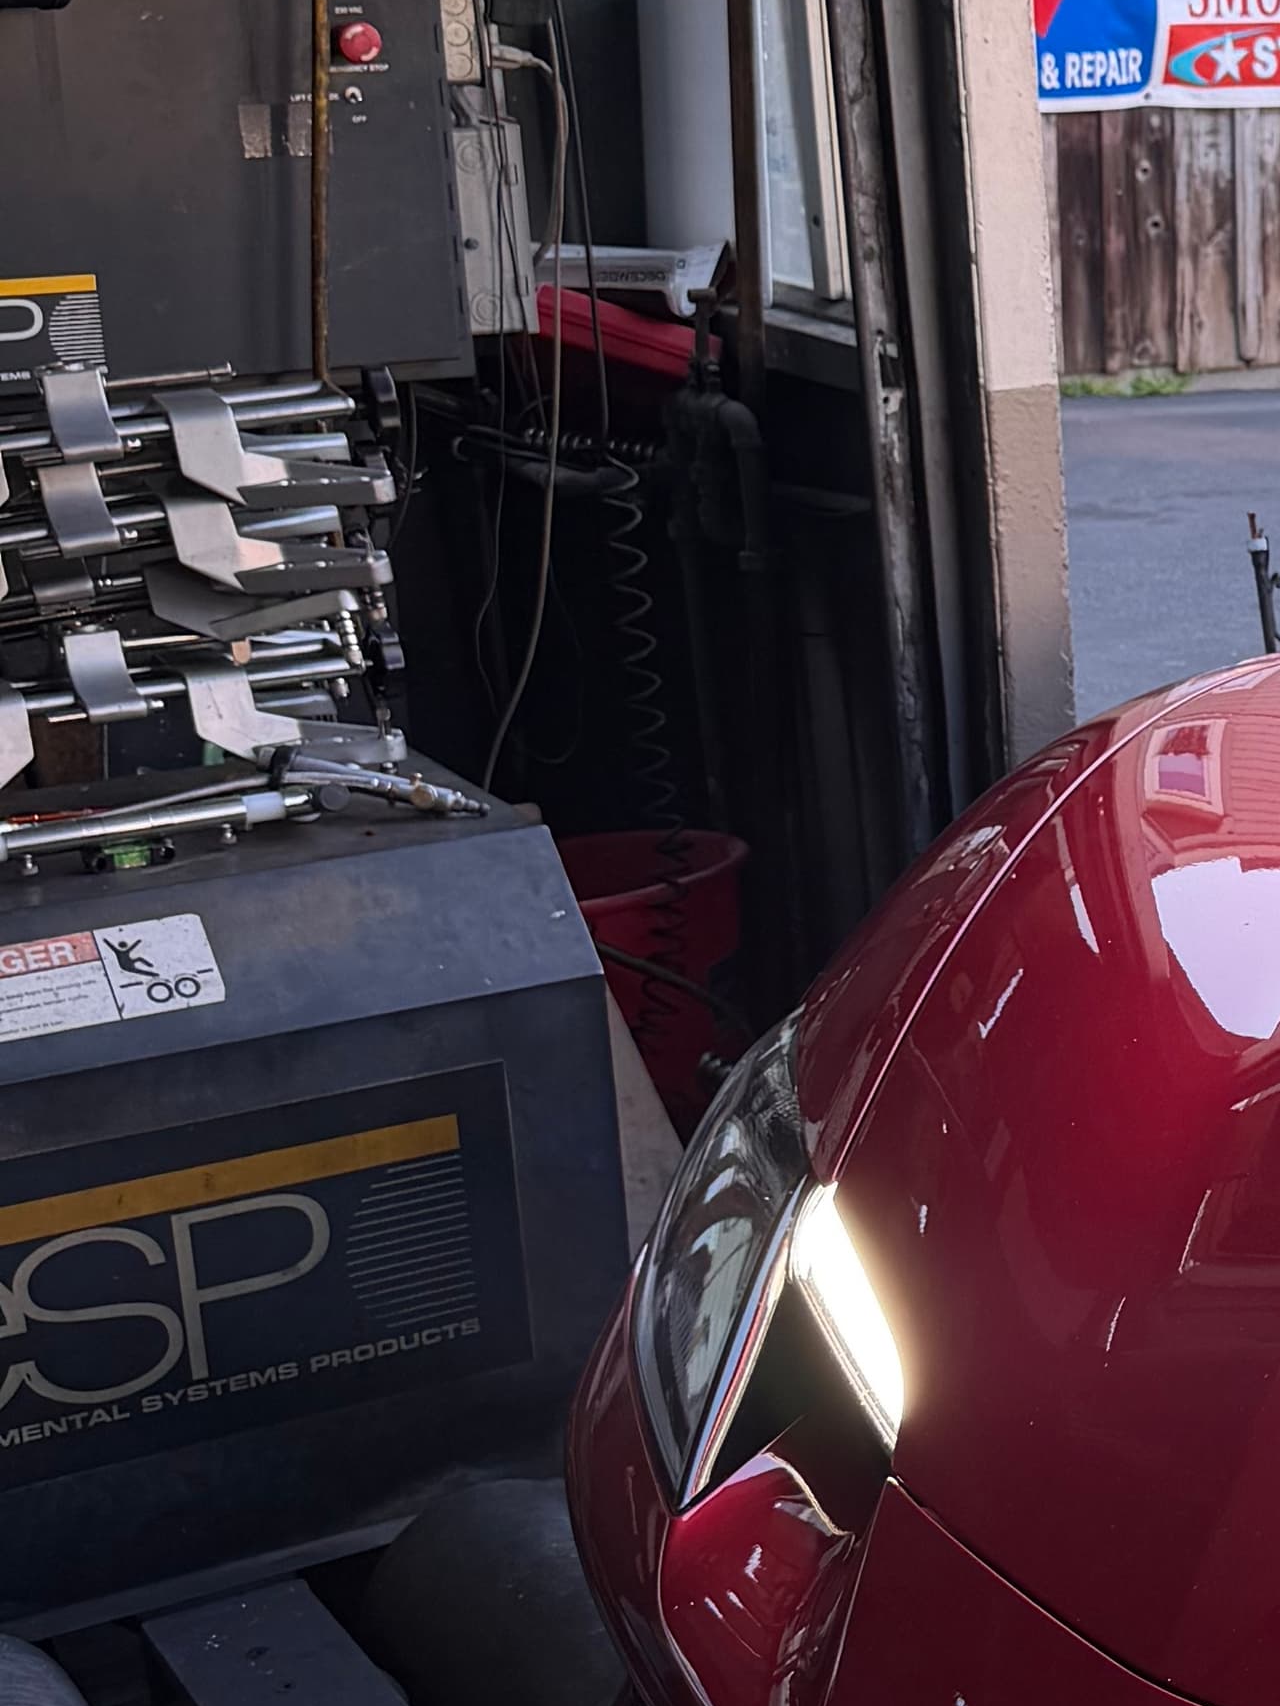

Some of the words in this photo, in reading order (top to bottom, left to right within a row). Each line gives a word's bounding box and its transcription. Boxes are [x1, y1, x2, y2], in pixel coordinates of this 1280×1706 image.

[1041, 52, 1061, 90] &
[1065, 47, 1143, 89] REPAIR
[141, 1361, 299, 1414] SYSTEMS
[310, 1317, 481, 1374] PRODUCTS
